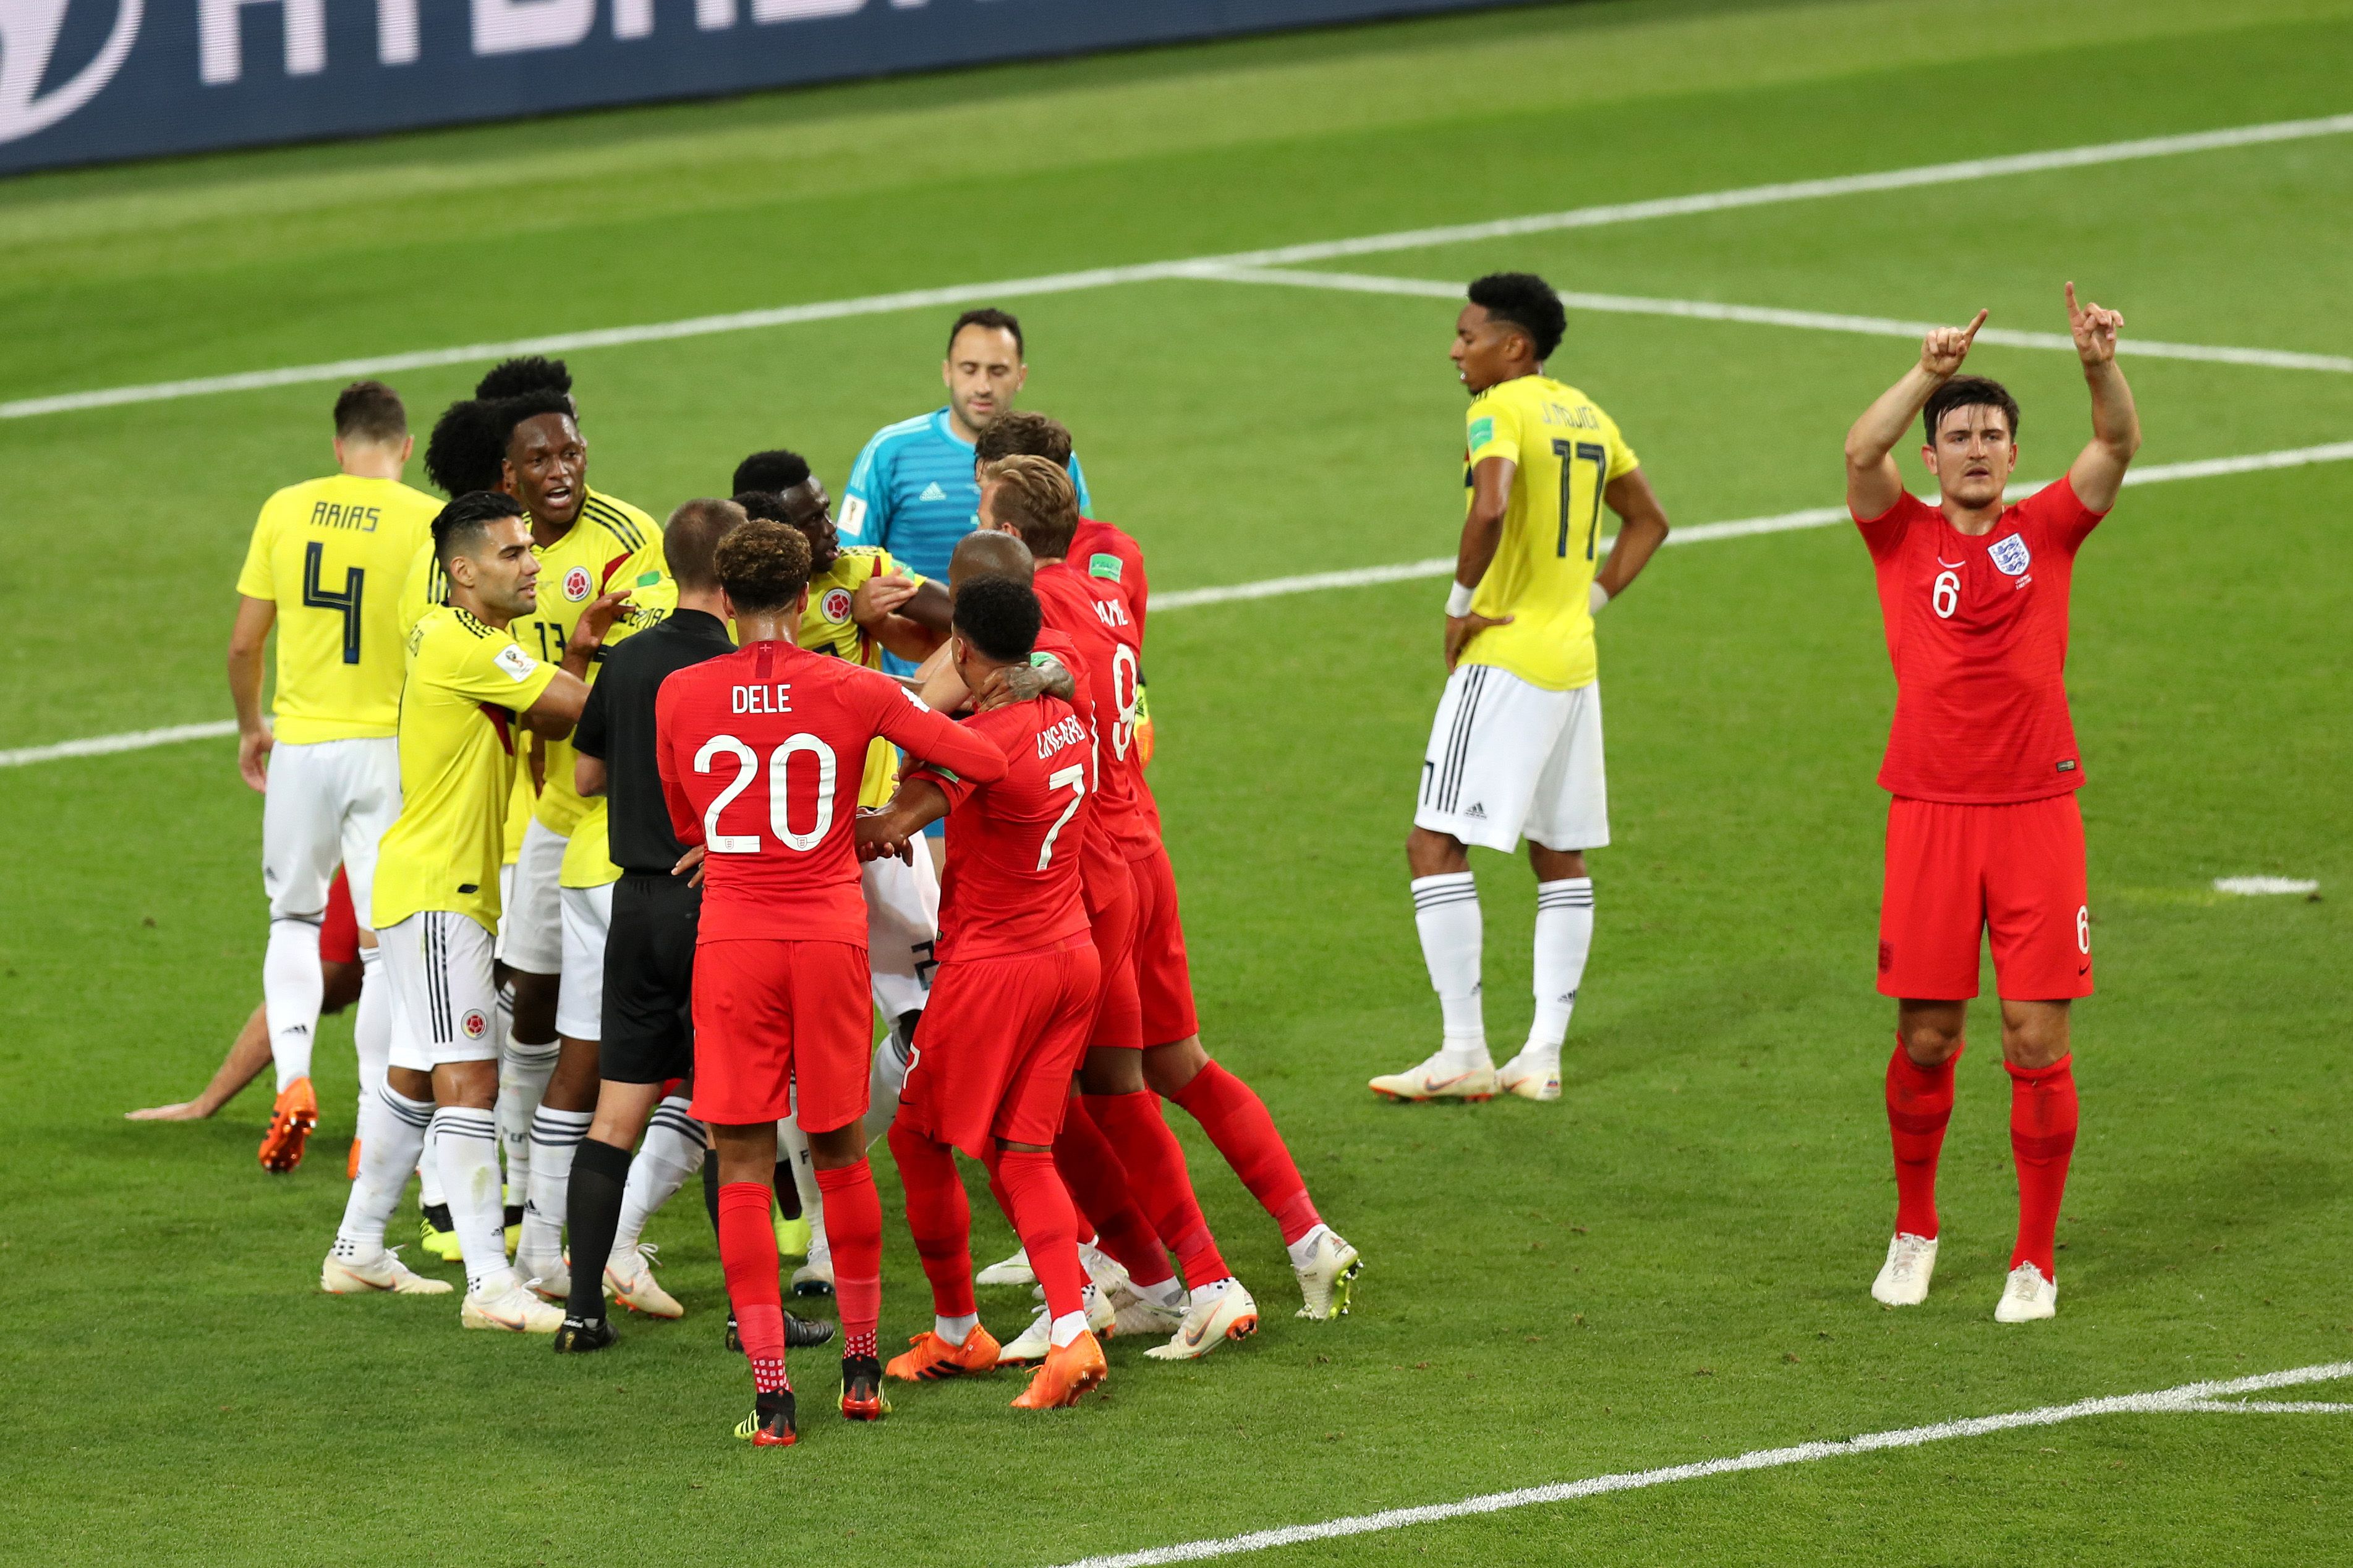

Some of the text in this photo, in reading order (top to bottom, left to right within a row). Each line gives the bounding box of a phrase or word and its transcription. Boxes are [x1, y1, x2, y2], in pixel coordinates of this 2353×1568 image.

[310, 501, 380, 532] ARIAS
[1552, 439, 1606, 561] 17
[304, 541, 364, 664] 4
[1933, 570, 1960, 619] 6
[732, 684, 792, 713] DELE
[1113, 643, 1136, 761] 9
[694, 732, 836, 853] 20
[1036, 763, 1086, 871] 7
[2077, 905, 2090, 955] 6
[903, 1042, 921, 1090] 7
